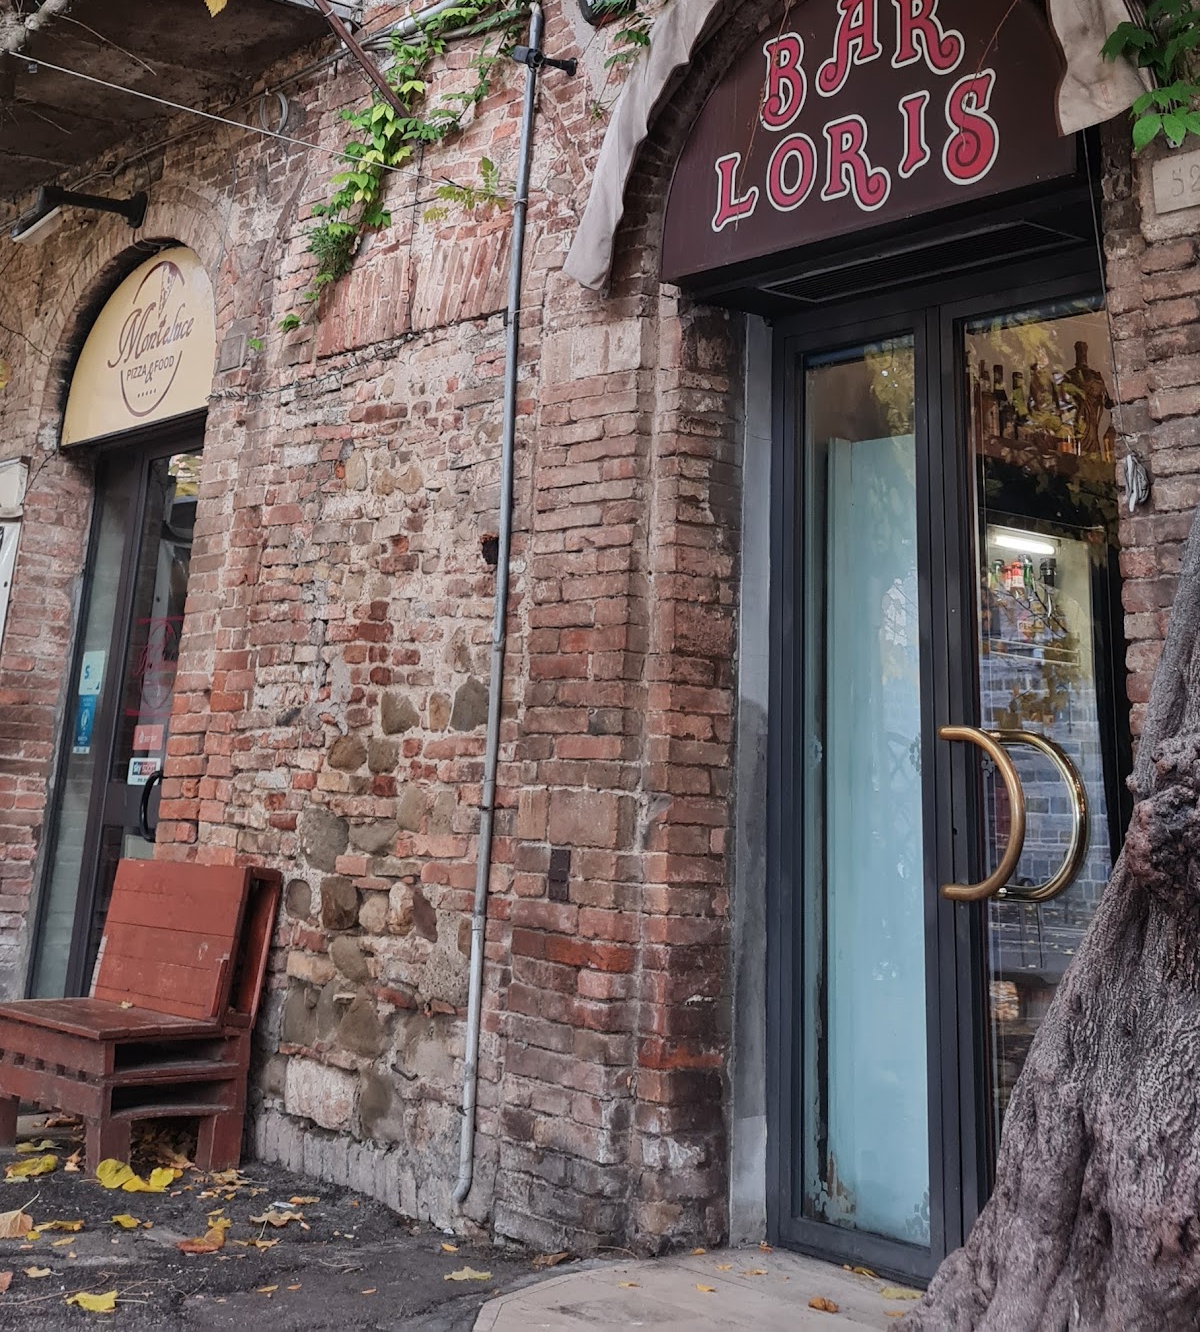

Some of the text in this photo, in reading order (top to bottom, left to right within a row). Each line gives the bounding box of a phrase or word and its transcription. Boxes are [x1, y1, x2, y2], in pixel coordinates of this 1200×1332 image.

[711, 68, 1000, 232] LORIS
[107, 302, 194, 368] Monteluce
[126, 364, 147, 381] PIZZA
[154, 355, 175, 372] FOOD
